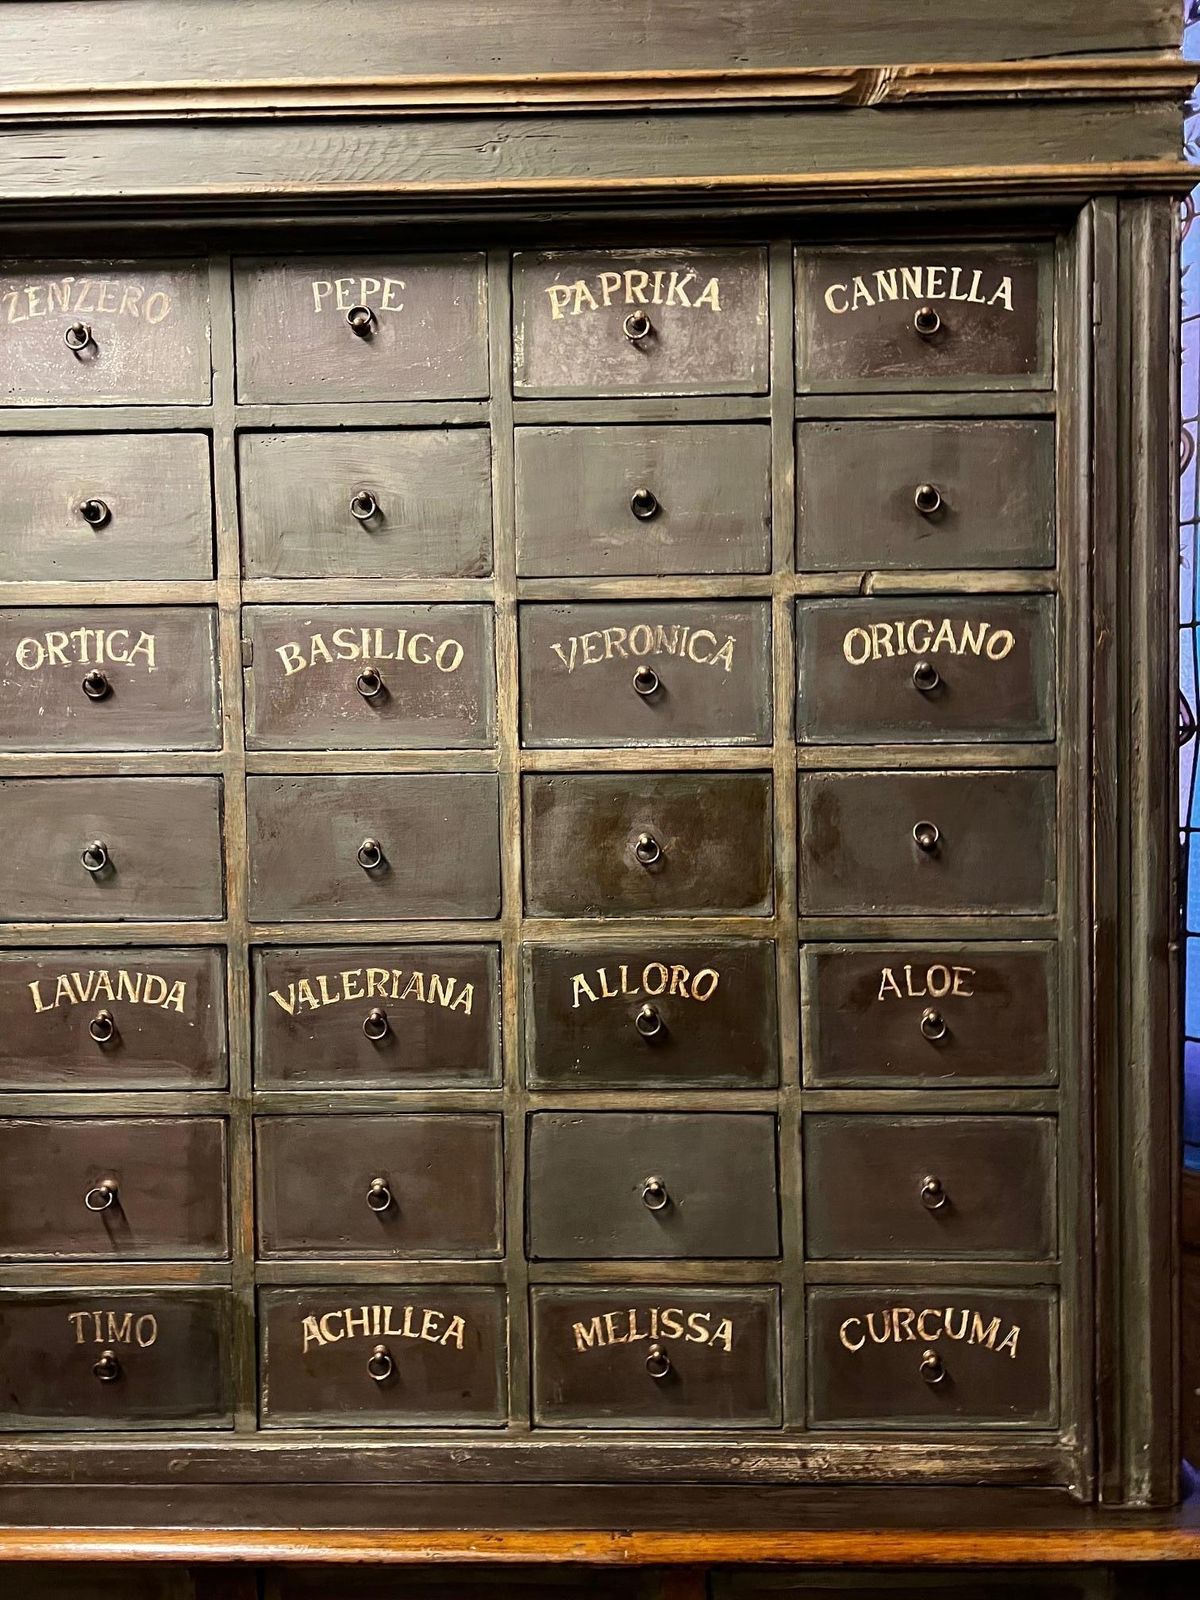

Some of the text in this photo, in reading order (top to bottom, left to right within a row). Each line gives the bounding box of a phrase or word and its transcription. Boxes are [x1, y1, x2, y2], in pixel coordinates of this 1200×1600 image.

[5, 276, 170, 325] ZENZERO
[312, 277, 405, 313] PEPE
[545, 270, 722, 320] PAPRIKA
[824, 266, 1014, 314] CANNELLA
[15, 627, 156, 673] ORTICA
[275, 628, 465, 677] BASILICO
[550, 624, 737, 674] VERONICA
[843, 619, 1015, 666] ORIGANO
[29, 970, 187, 1014] LAVANDA
[269, 967, 475, 1016] VALERIANA
[569, 962, 720, 1008] ALLORO
[878, 965, 976, 1001] ALOE
[68, 1310, 159, 1348] TIMO
[301, 1305, 467, 1354] ACHILLEA
[573, 1307, 735, 1354] MELISSA
[838, 1307, 1022, 1359] CURCUMA
